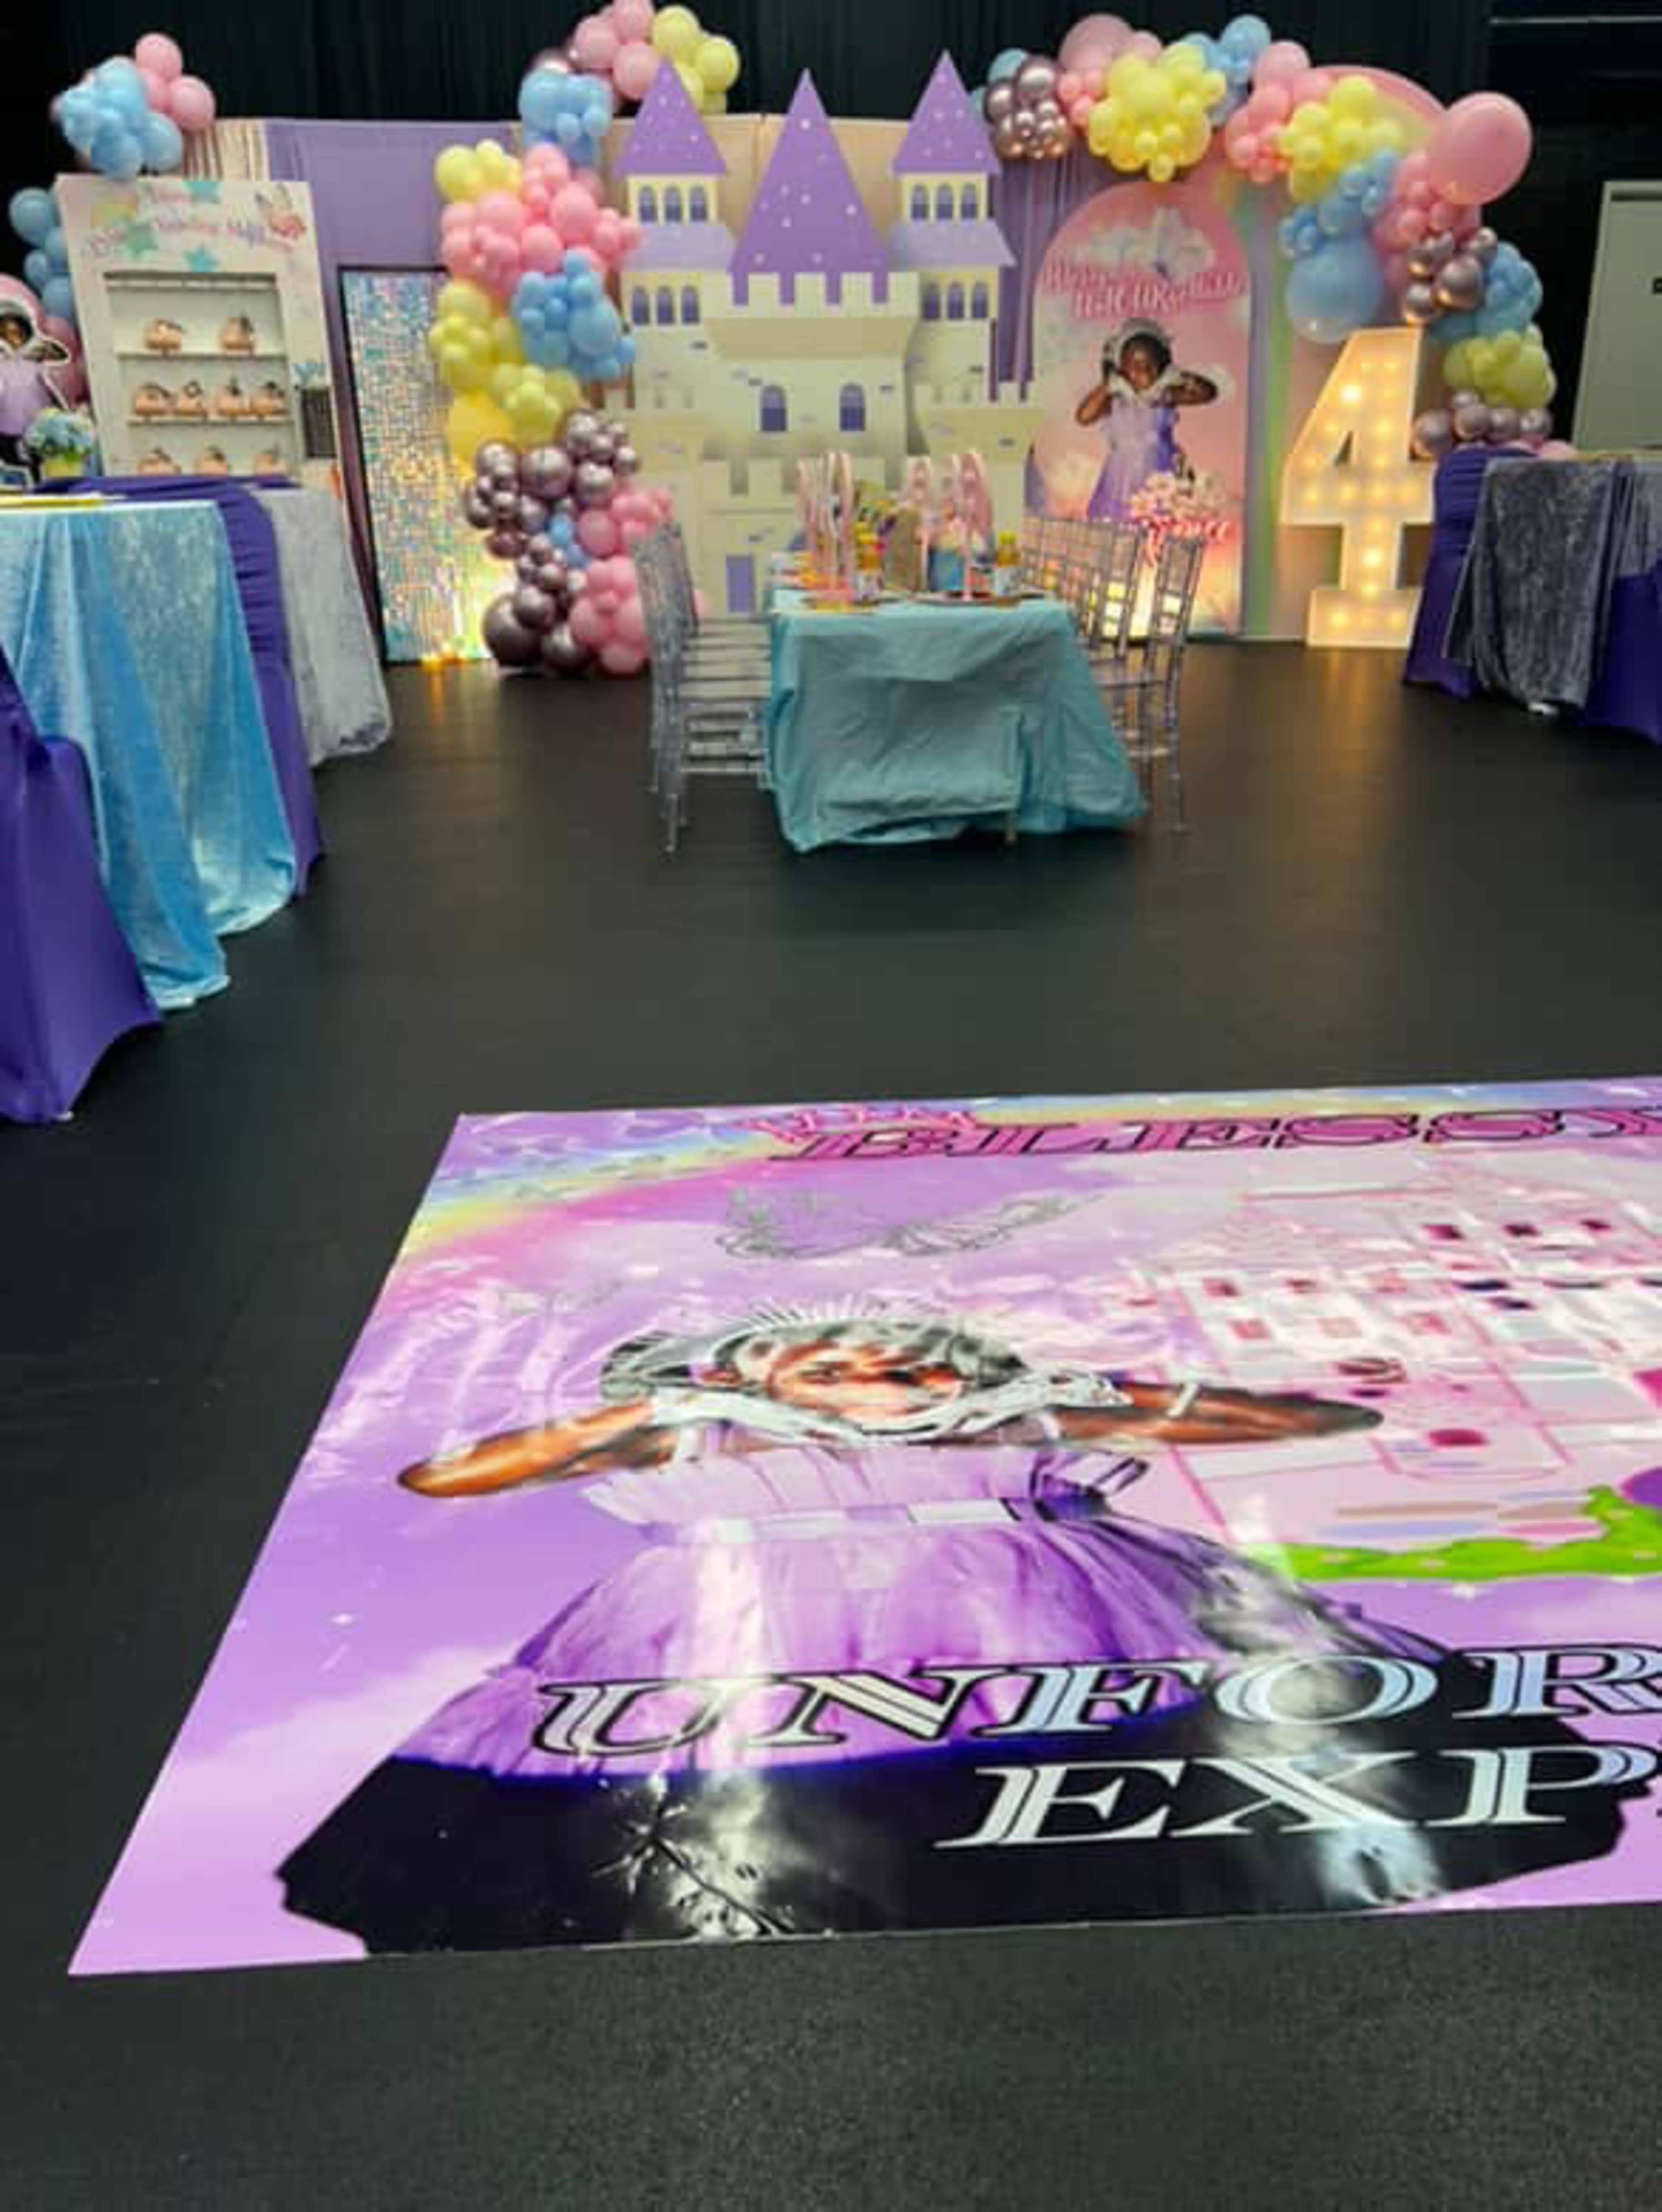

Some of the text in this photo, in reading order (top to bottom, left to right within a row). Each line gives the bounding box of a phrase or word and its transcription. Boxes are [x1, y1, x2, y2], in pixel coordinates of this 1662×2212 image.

[1279, 325, 1437, 648] 4
[533, 1644, 1662, 1755] UNFOR
[932, 1744, 1659, 1849] EXP
